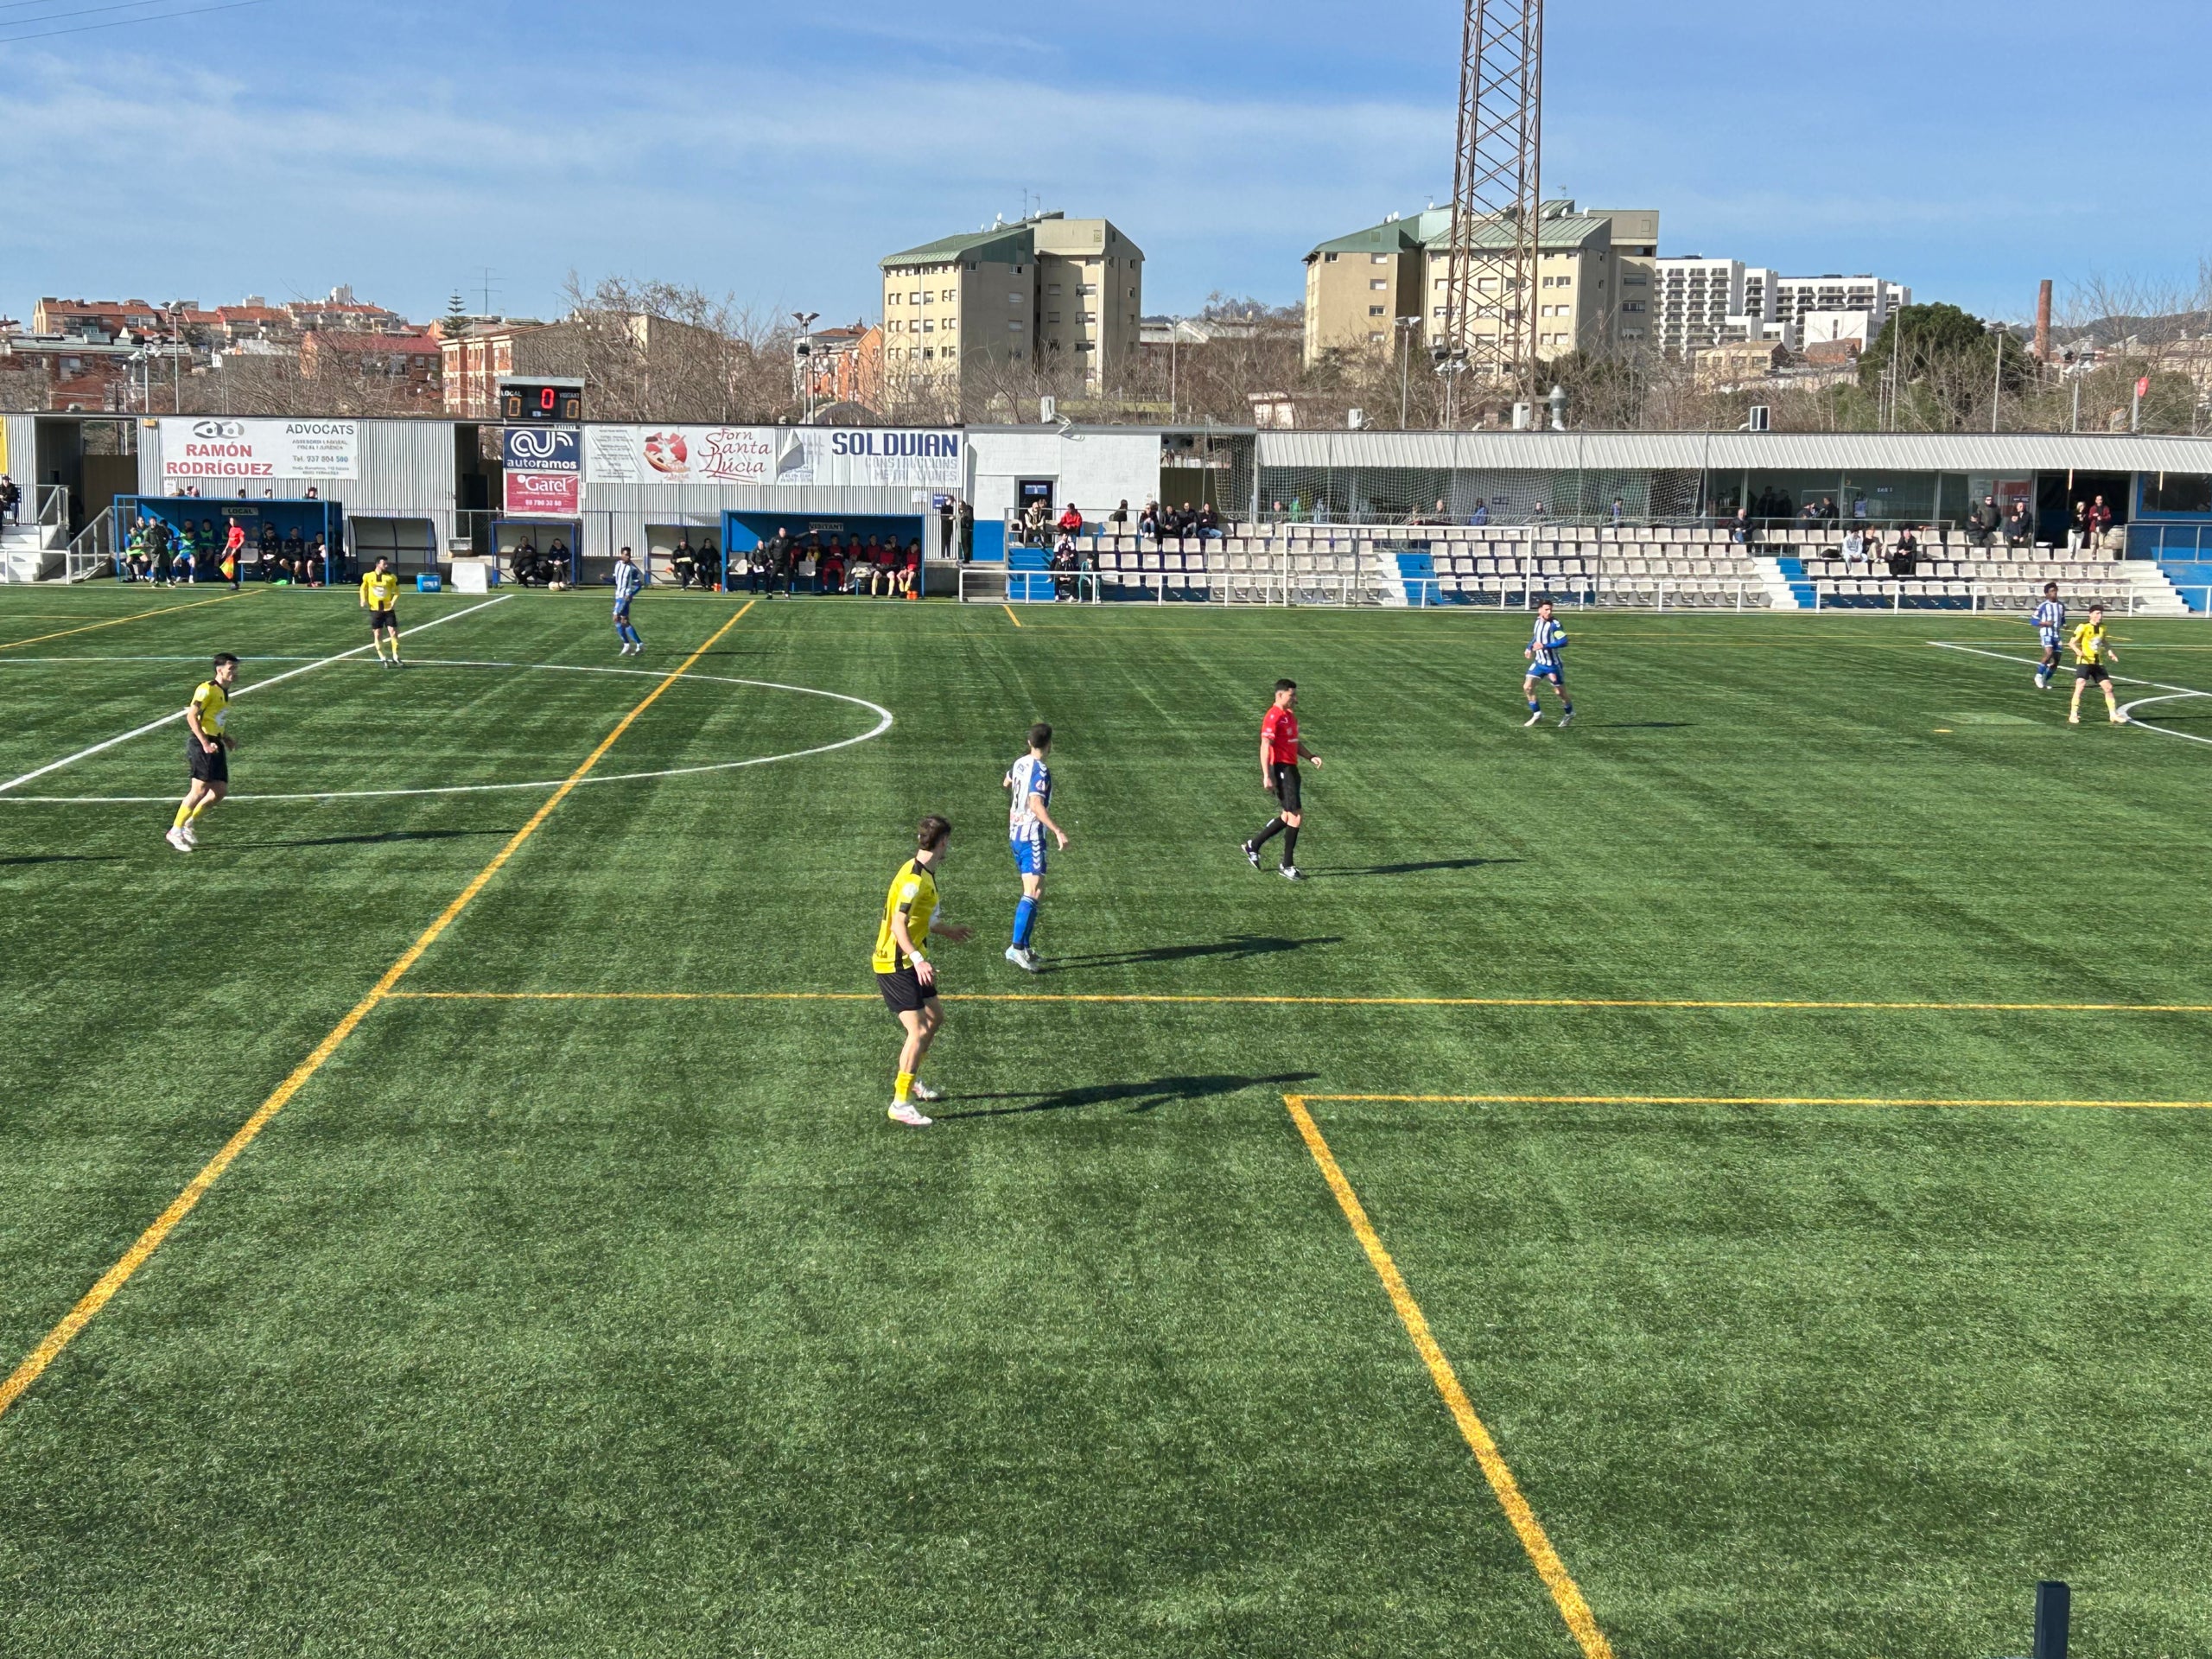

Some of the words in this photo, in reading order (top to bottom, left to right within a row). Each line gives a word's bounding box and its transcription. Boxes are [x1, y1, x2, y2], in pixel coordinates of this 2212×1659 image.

[541, 388, 555, 409] 0
[286, 423, 354, 435] ADVOCATS
[714, 428, 753, 442] Forn
[186, 442, 252, 458] RAMÓN
[698, 432, 772, 456] Santa
[166, 460, 273, 476] RODRÍGUEZ
[507, 459, 577, 469] autoramos
